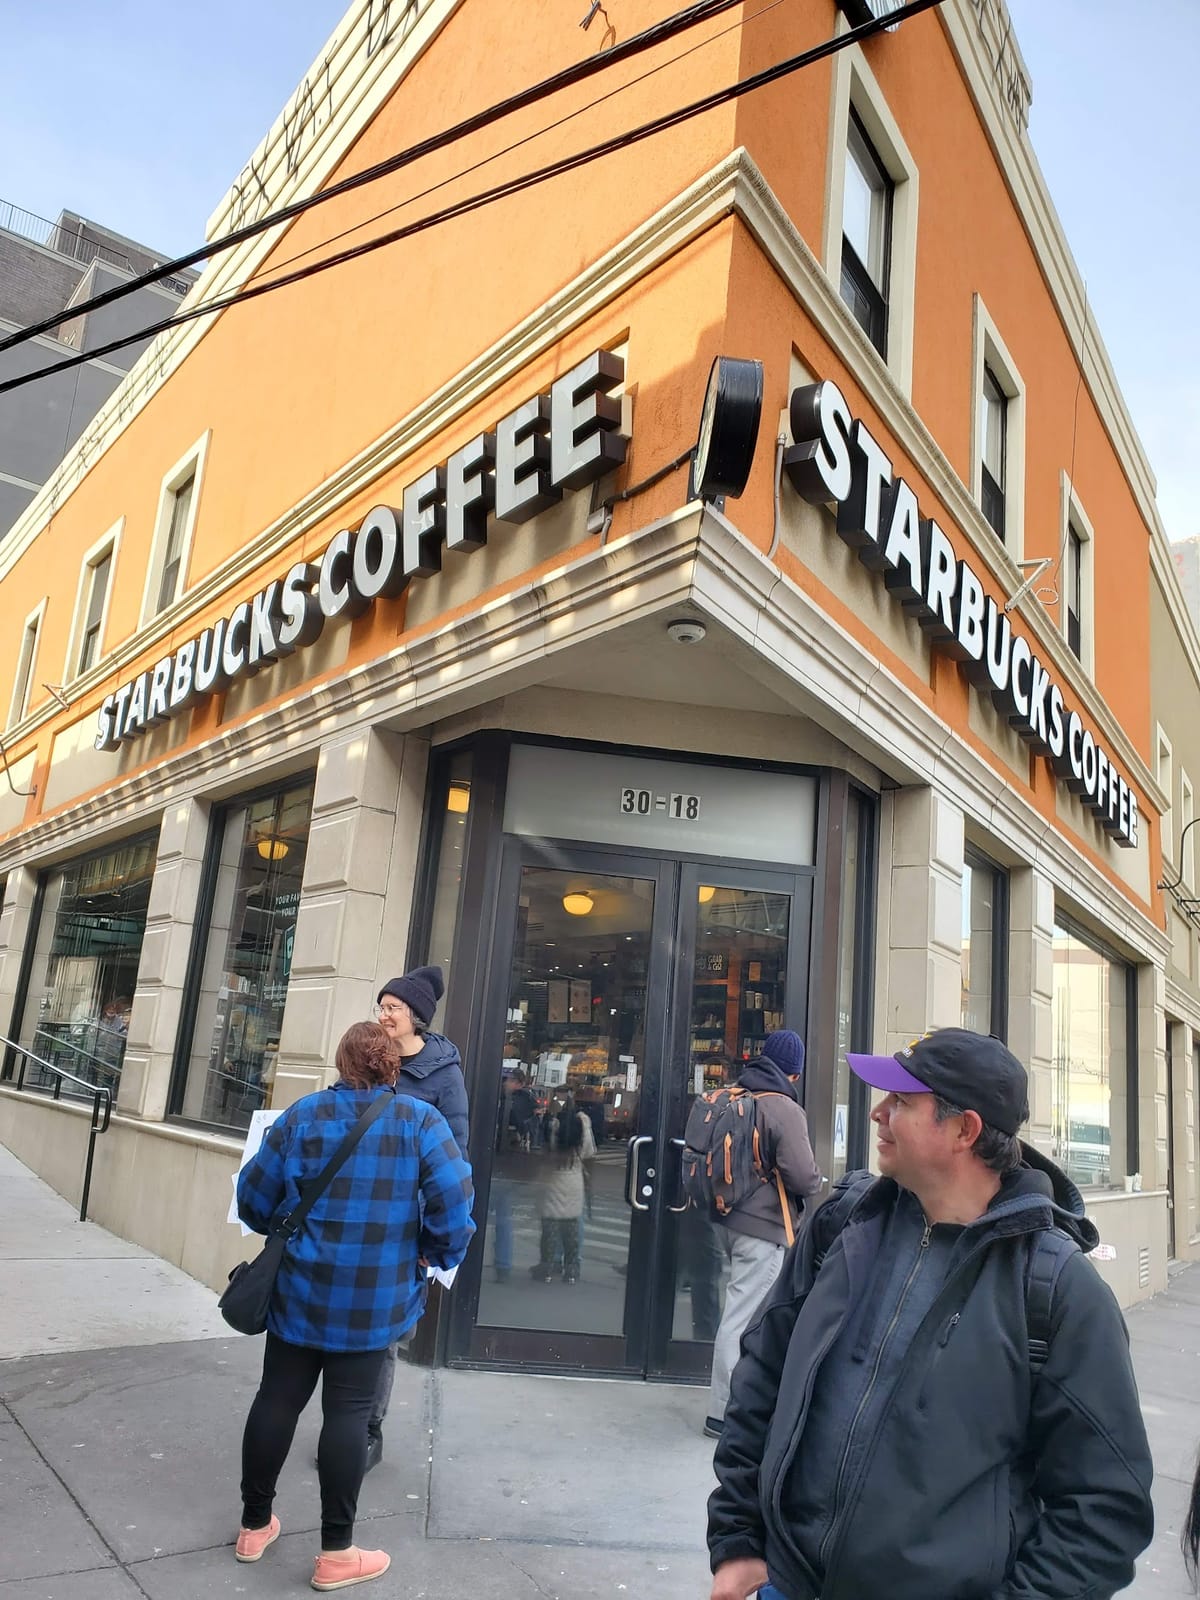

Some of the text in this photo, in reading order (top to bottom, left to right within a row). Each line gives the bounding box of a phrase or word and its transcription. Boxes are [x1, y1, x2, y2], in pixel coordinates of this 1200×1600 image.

[95, 348, 622, 752] STARBUCKS COFFEE
[793, 379, 1138, 848] STARBUCKS COFFEE
[622, 789, 699, 820] 30-18
[833, 1111, 844, 1142] A
